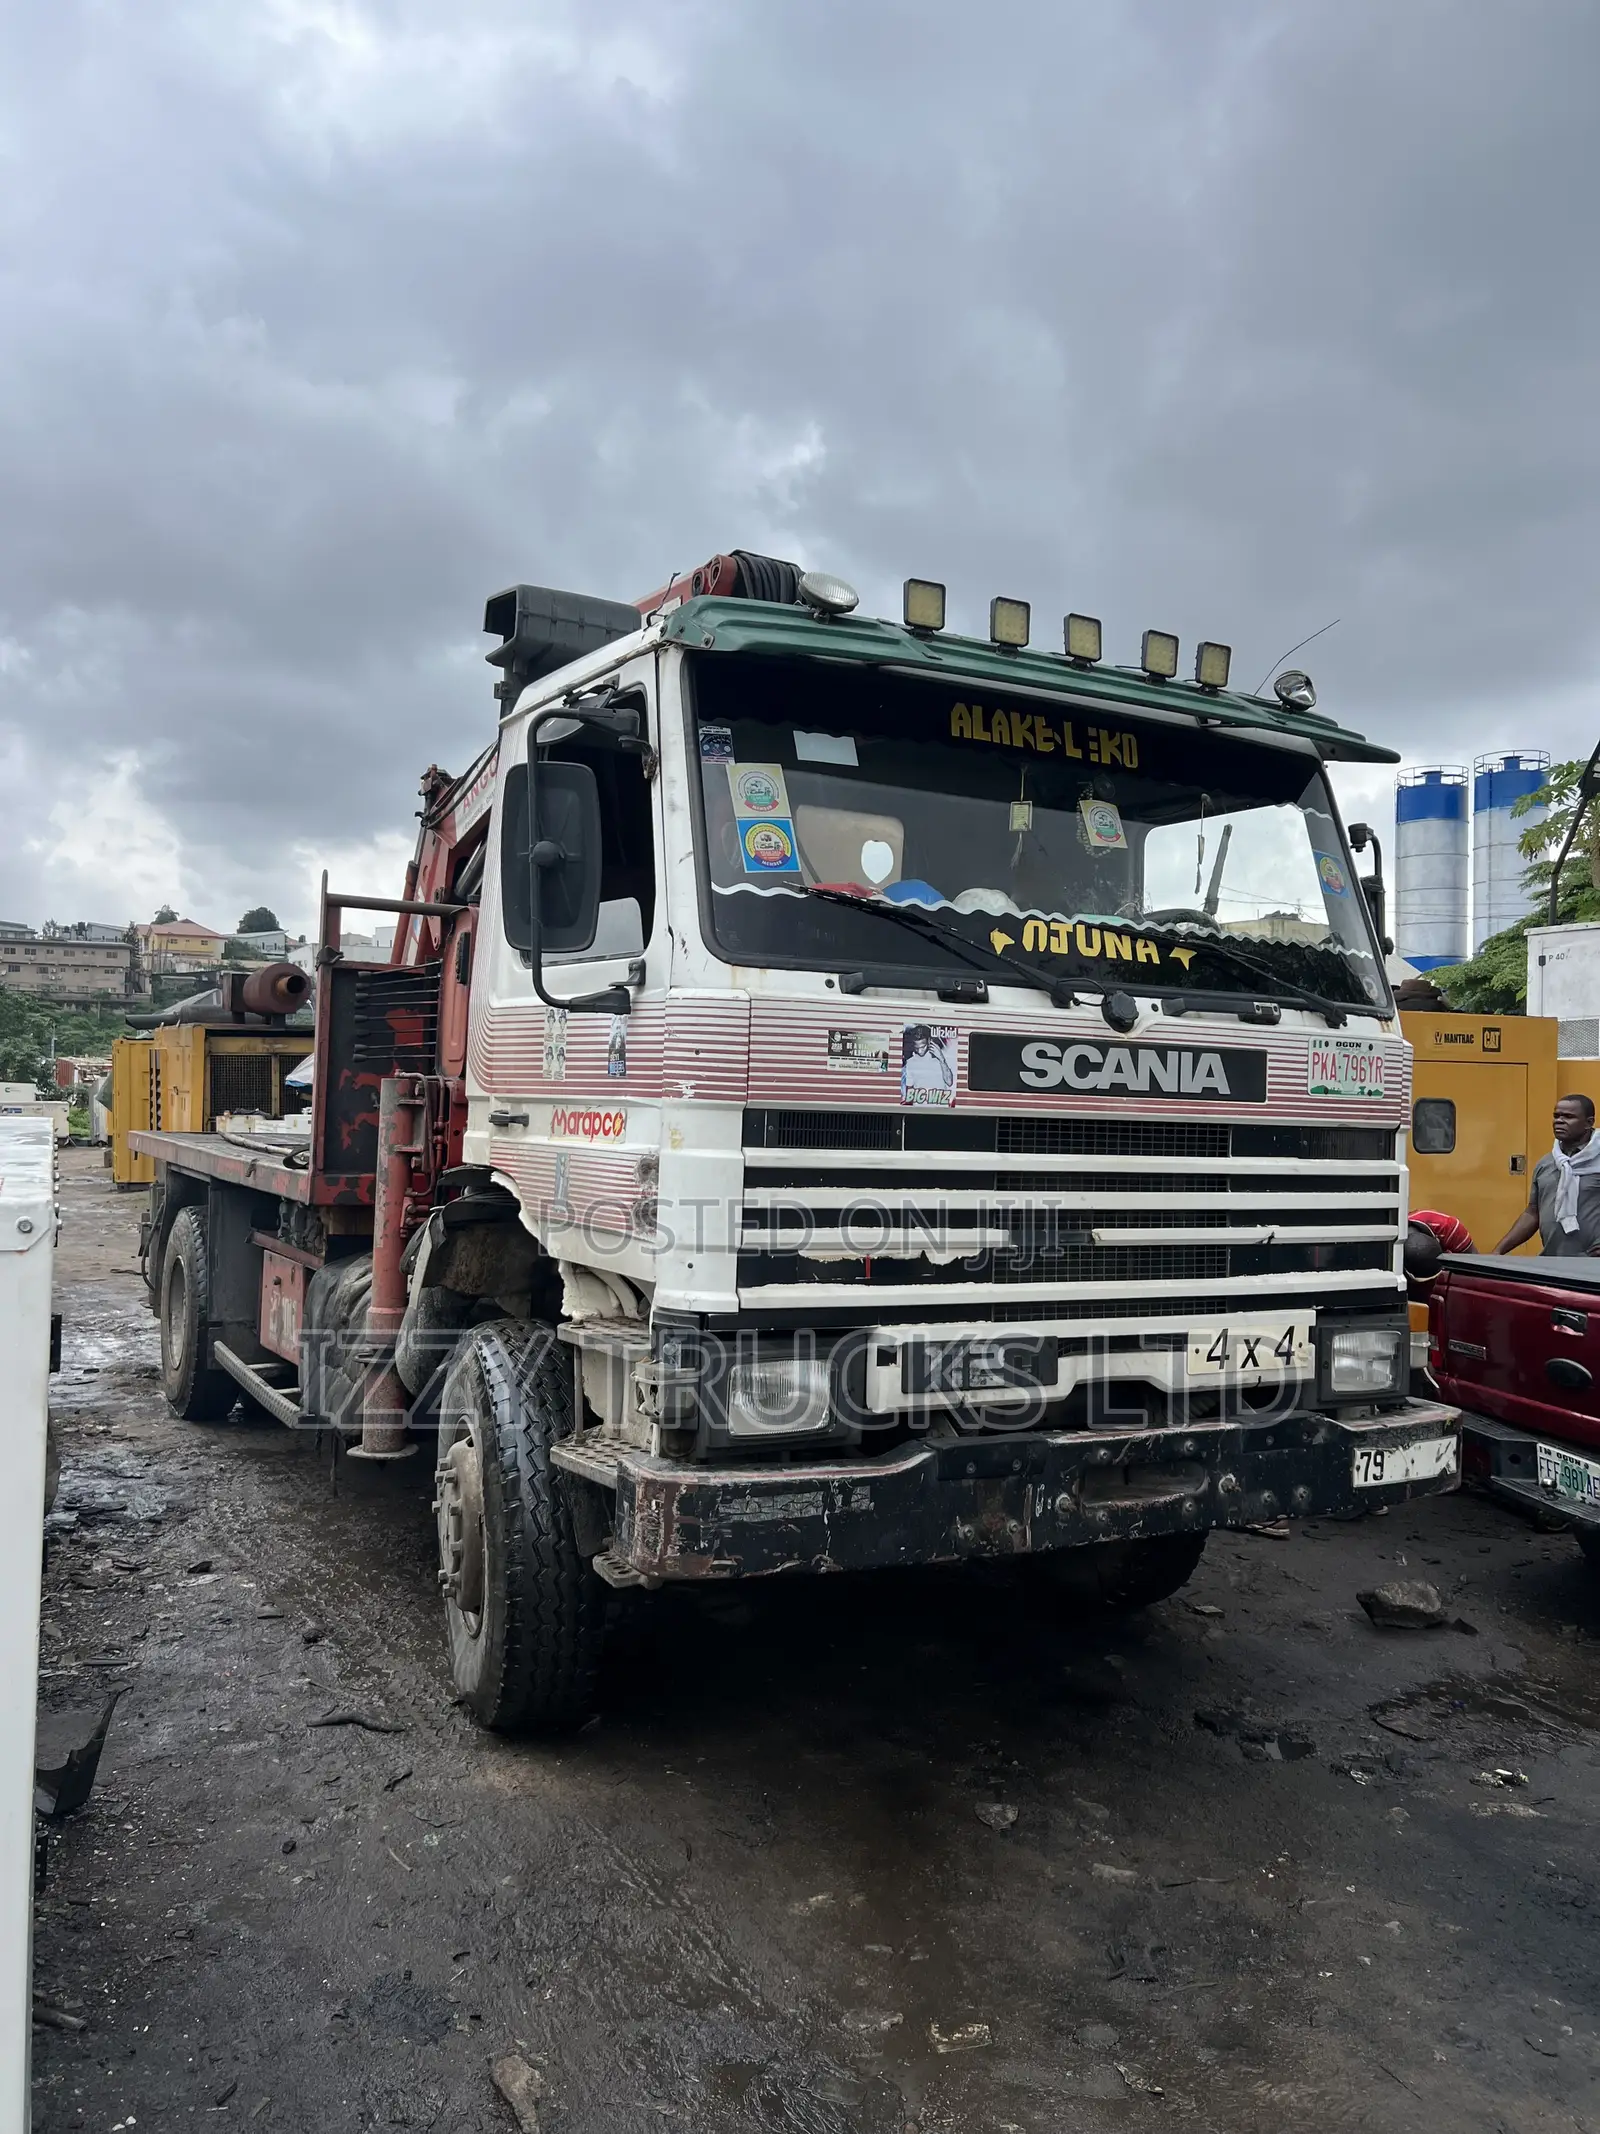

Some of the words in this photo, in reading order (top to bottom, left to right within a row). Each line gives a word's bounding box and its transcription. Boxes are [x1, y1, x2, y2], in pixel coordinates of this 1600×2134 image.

[930, 1026, 957, 1039] Wizkid
[1335, 1041, 1362, 1049] OGUN
[1443, 1033, 1475, 1044] MANTRAC
[1482, 1029, 1501, 1050] CAT
[1019, 1042, 1231, 1095] SCANIA
[905, 1087, 928, 1104] BIG
[927, 1087, 951, 1105] WIZ
[551, 1108, 625, 1143] Marapco
[1206, 1328, 1230, 1370] 4
[1274, 1325, 1296, 1366] 4
[1360, 1450, 1385, 1482] 79
